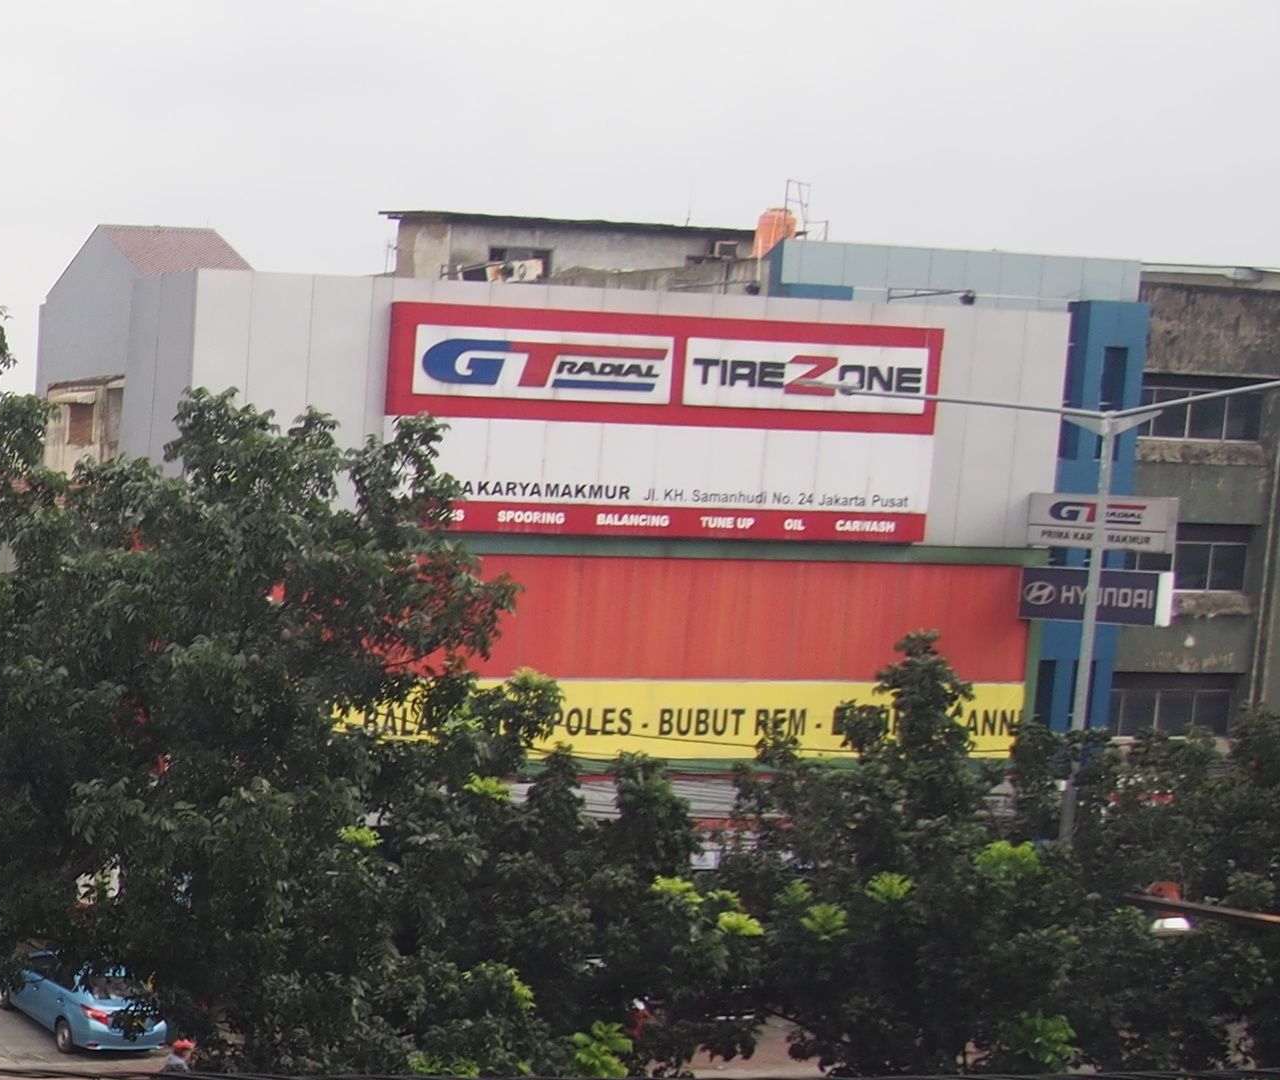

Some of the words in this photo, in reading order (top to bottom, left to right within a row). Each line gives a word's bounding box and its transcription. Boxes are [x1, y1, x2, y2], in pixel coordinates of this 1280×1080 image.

[556, 360, 660, 378] RADIAL
[692, 490, 767, 504] Samanhudi
[773, 492, 793, 505] No.
[798, 492, 814, 505] 24
[818, 493, 866, 507] Jakarta
[872, 494, 909, 508] Pusat
[497, 509, 565, 524] SPOORING
[596, 513, 670, 527] BALANCING
[700, 516, 734, 529] TUNE
[736, 517, 755, 529] UP
[783, 518, 806, 531] OIL
[835, 520, 896, 533] CARWASH
[1041, 529, 1070, 540] PRIMA
[1107, 534, 1152, 545] MAKMUR
[658, 708, 746, 737] BUBUT
